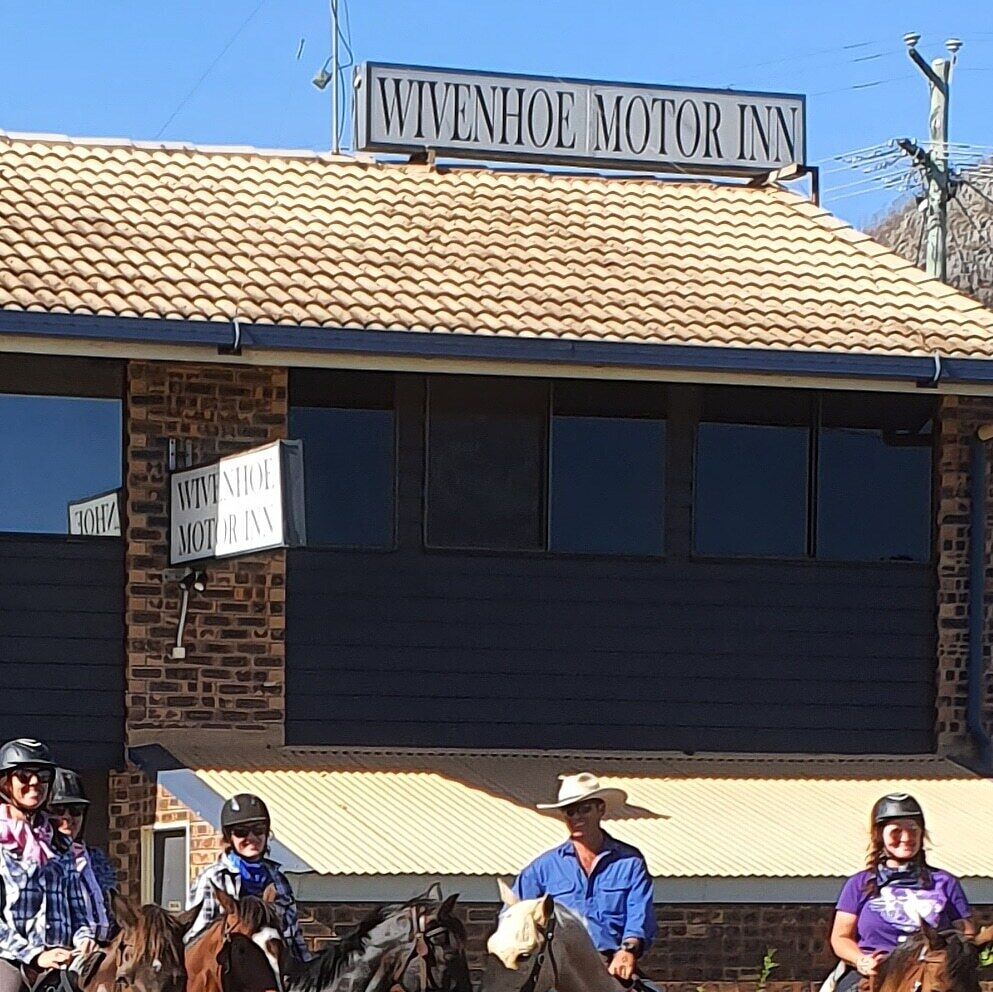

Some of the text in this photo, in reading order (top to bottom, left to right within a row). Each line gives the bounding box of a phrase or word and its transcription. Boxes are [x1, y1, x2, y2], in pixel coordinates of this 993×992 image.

[378, 77, 797, 164] WIVENHOE MOTOR INN
[177, 458, 275, 511] WIVENHOE
[178, 506, 273, 556] MOTOR INN
